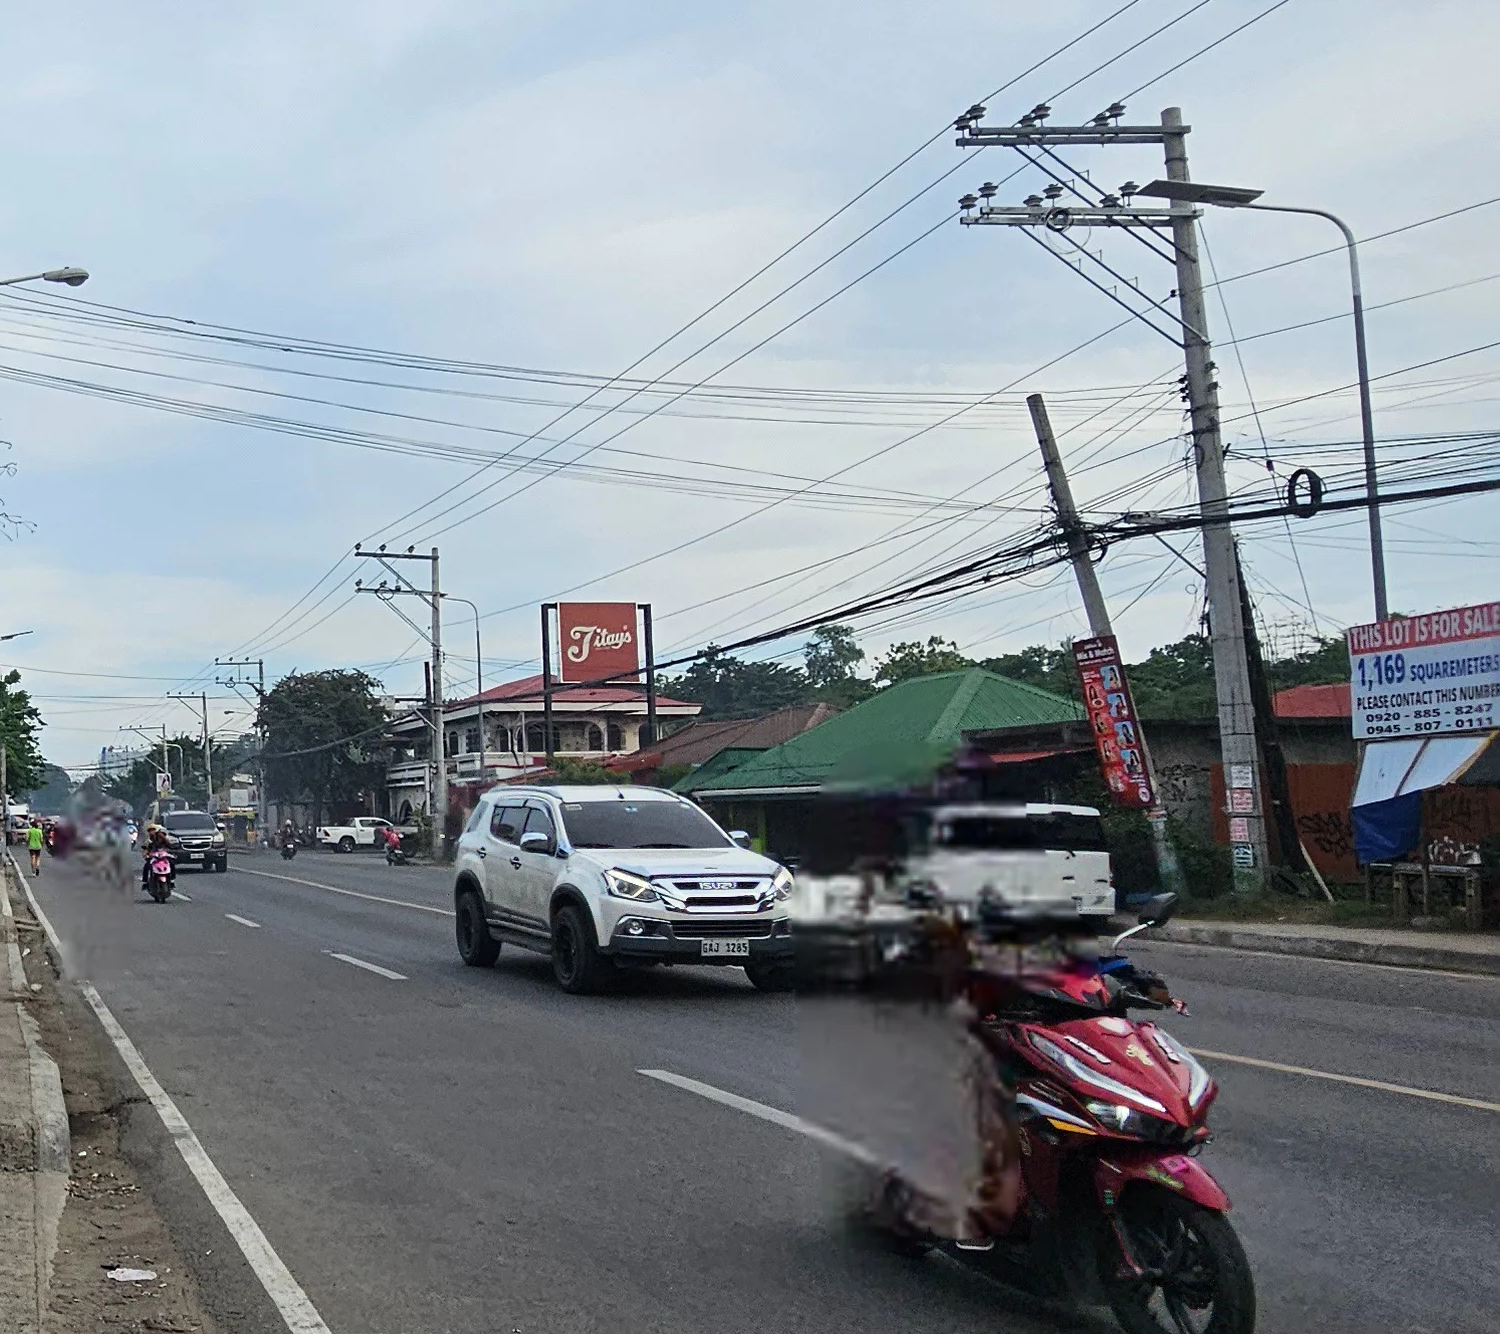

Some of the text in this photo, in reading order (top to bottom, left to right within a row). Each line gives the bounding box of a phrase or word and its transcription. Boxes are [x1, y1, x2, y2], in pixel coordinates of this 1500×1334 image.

[1350, 604, 1500, 650] THIS LOT IS FOR SALE
[1358, 653, 1500, 691] 1,169 SQUAREMETERS
[1356, 694, 1389, 710] PLEASE
[1390, 690, 1433, 708] CONTACT
[1435, 687, 1457, 703] THIS
[1366, 712, 1401, 723] 0920
[1413, 708, 1441, 719] 885
[1454, 703, 1493, 716] 8247
[1366, 724, 1401, 735] 0945
[1414, 720, 1441, 731] 807
[1455, 716, 1493, 729] 0111
